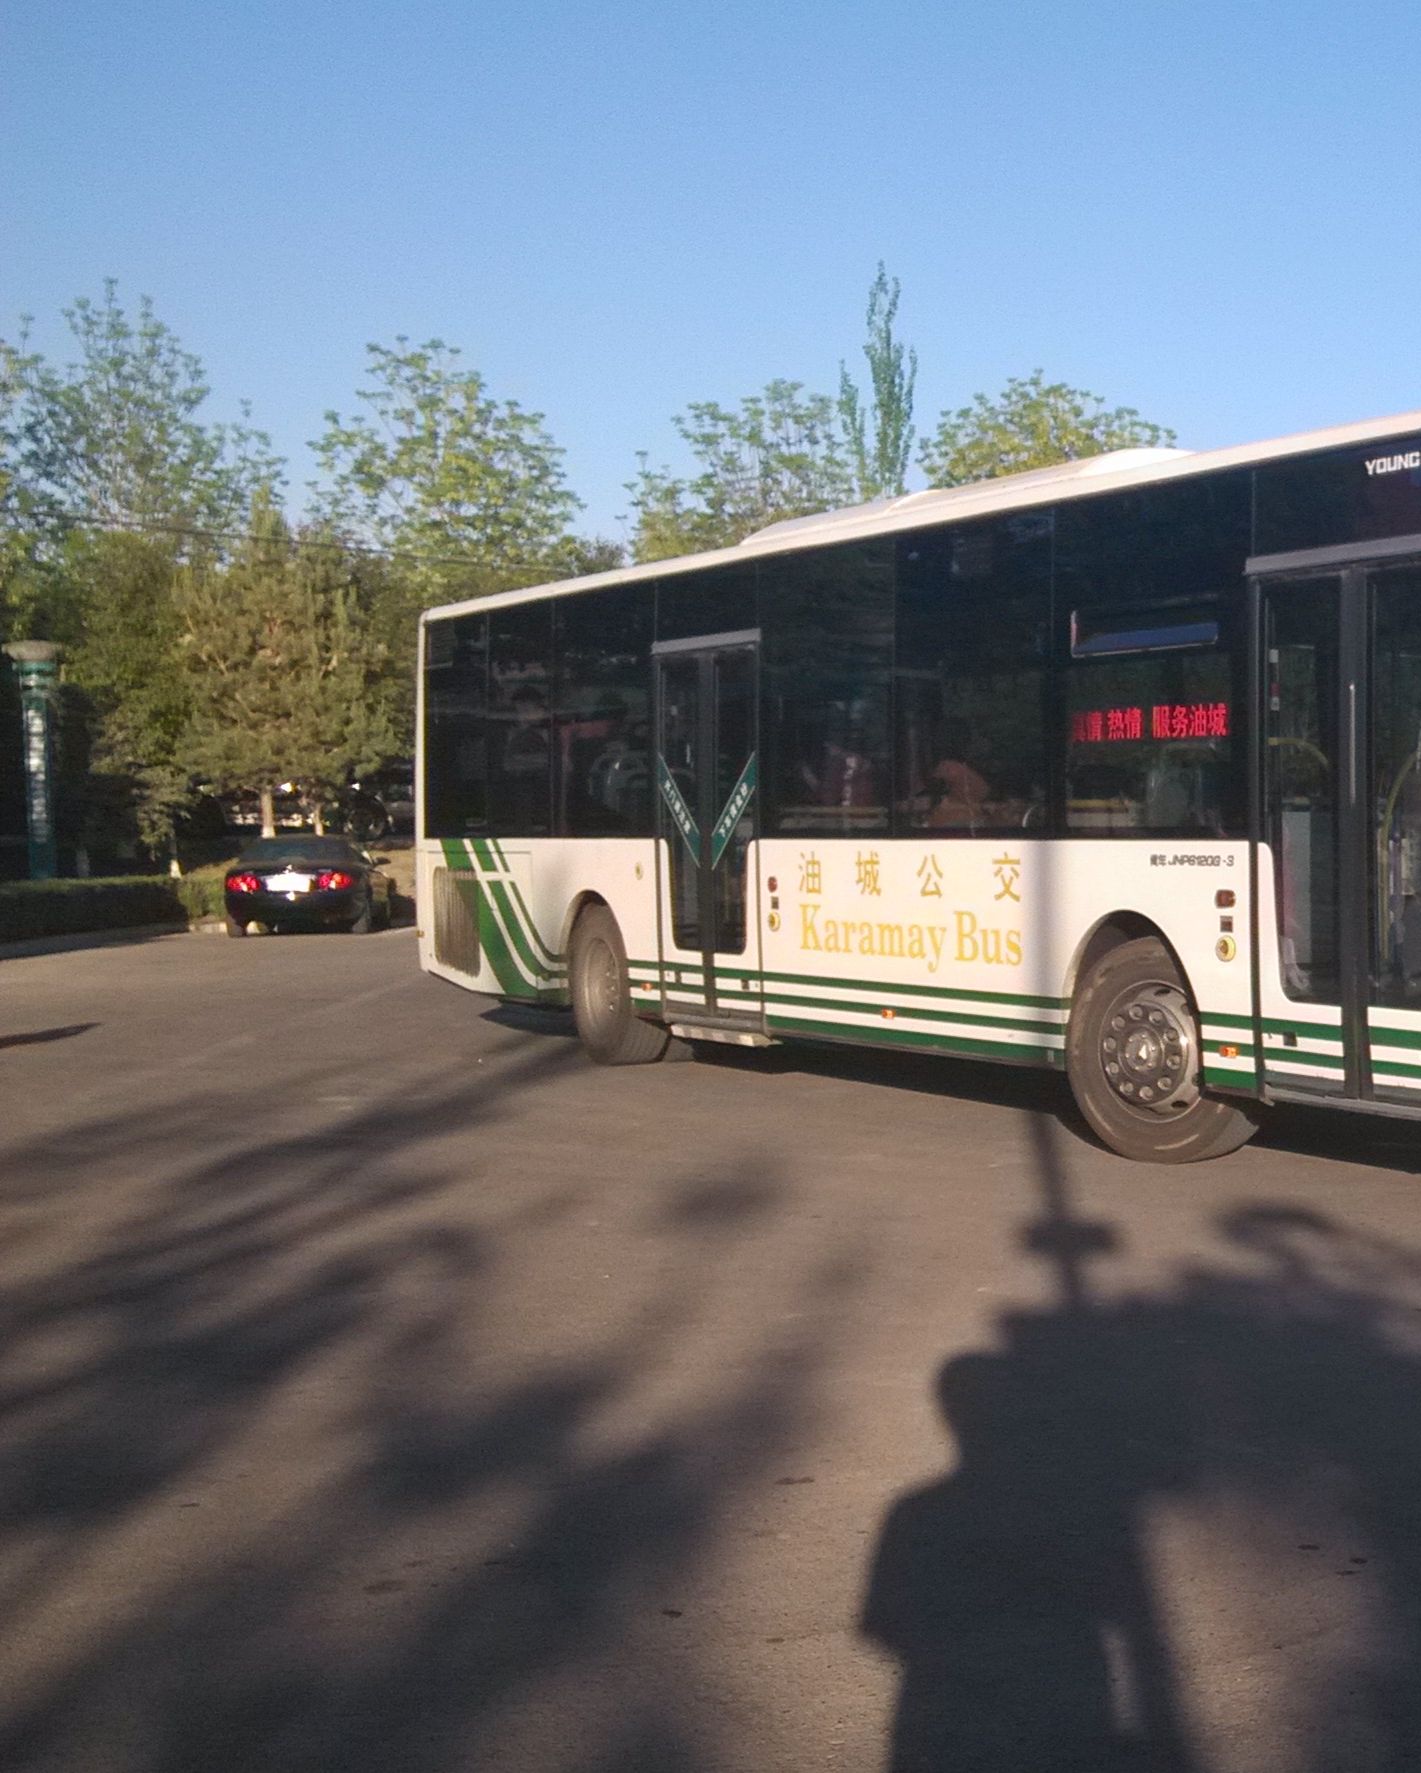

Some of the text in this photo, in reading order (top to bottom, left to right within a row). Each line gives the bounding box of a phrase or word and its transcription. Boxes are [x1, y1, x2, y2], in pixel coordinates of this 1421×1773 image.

[1107, 707, 1142, 740] 热情
[1152, 703, 1228, 738] 服务油城
[799, 903, 1023, 973] Karamay Bus
